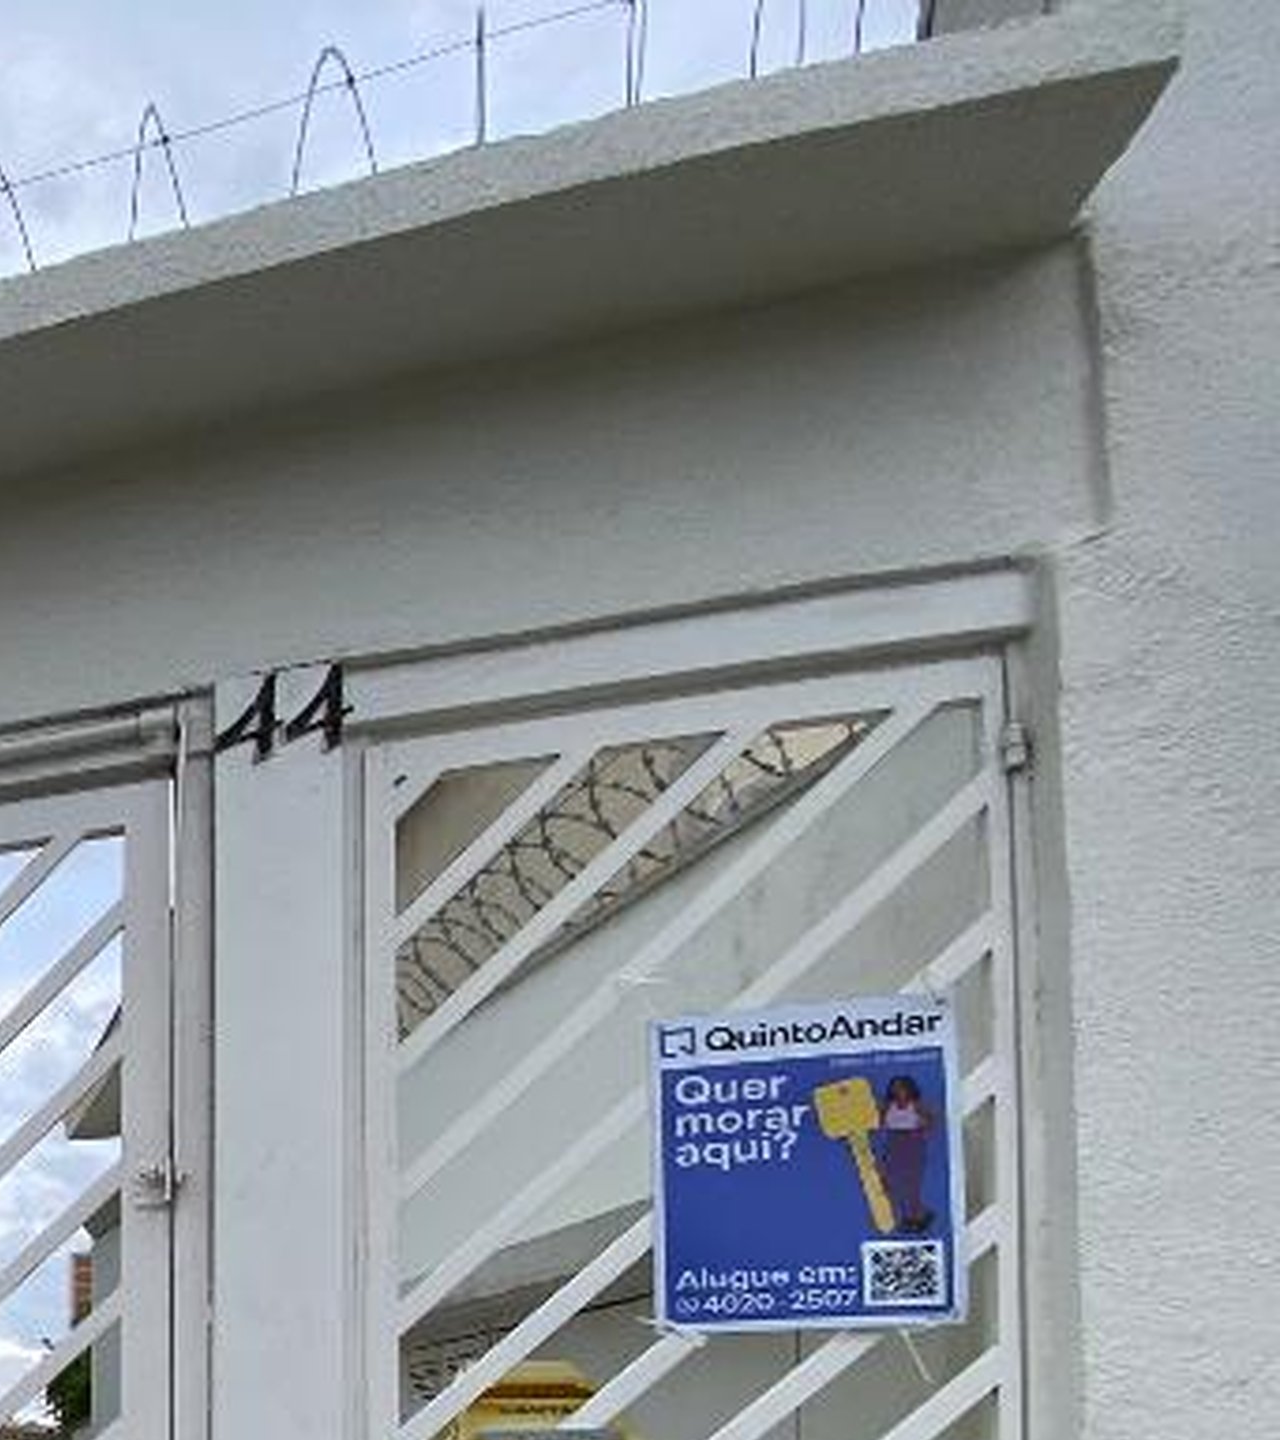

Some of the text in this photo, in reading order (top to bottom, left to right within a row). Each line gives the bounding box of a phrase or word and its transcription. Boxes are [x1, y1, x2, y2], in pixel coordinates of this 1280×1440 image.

[214, 660, 354, 766] 44
[705, 1012, 942, 1051] QuintoAndar
[676, 1075, 788, 1104] Quer
[675, 1104, 811, 1137] morar
[675, 1132, 799, 1171] aqui?
[676, 1268, 790, 1291] Alugue
